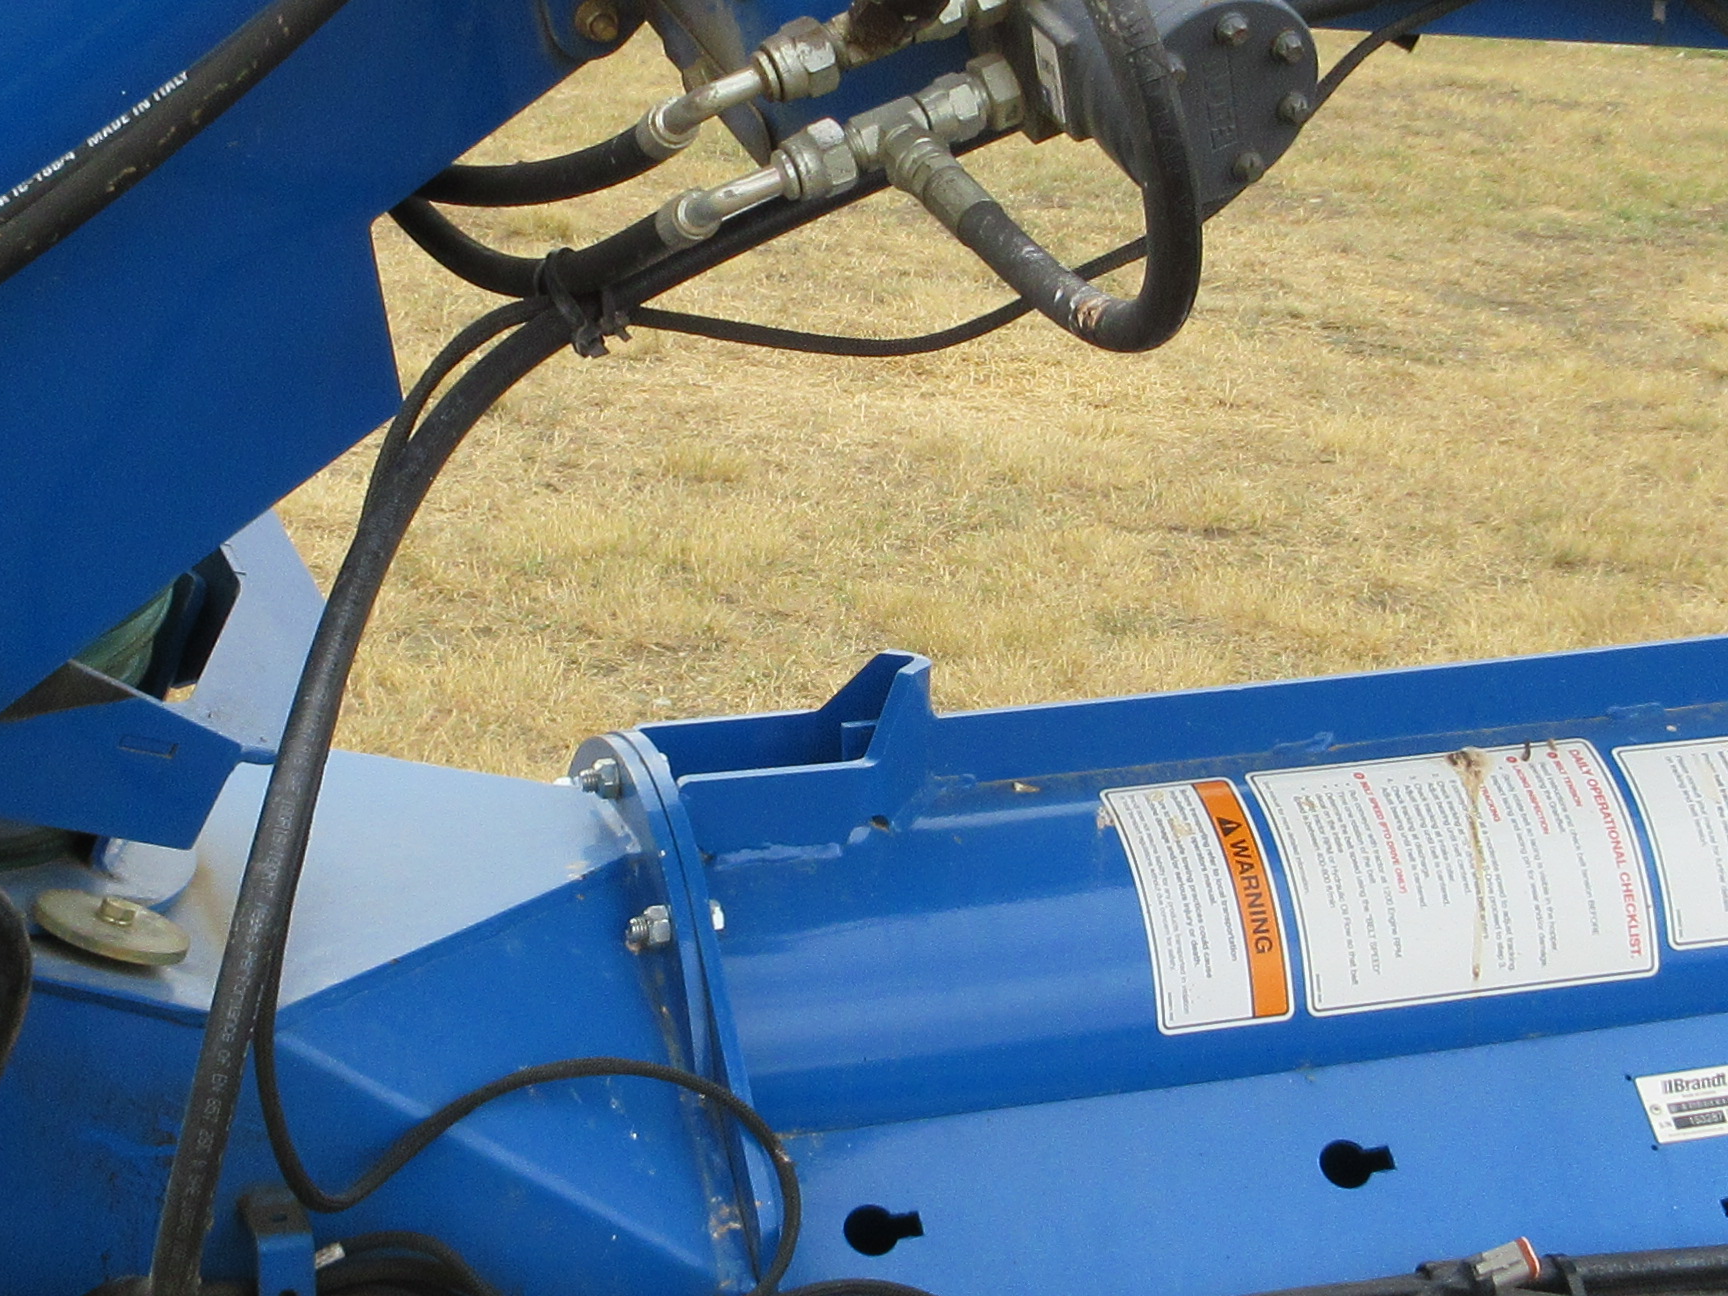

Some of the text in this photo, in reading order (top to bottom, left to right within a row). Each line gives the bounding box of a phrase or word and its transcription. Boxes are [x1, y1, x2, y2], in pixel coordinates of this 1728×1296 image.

[85, 112, 131, 149] MADE
[130, 97, 152, 117] IN
[150, 69, 191, 103] ITALY
[1566, 748, 1642, 959] DAILY OPERATIONAL CHECKLIST.
[1219, 900, 1237, 961] transportation
[1230, 839, 1273, 954] WARNING
[1199, 925, 1210, 949] could
[1672, 1073, 1727, 1092] Brandt
